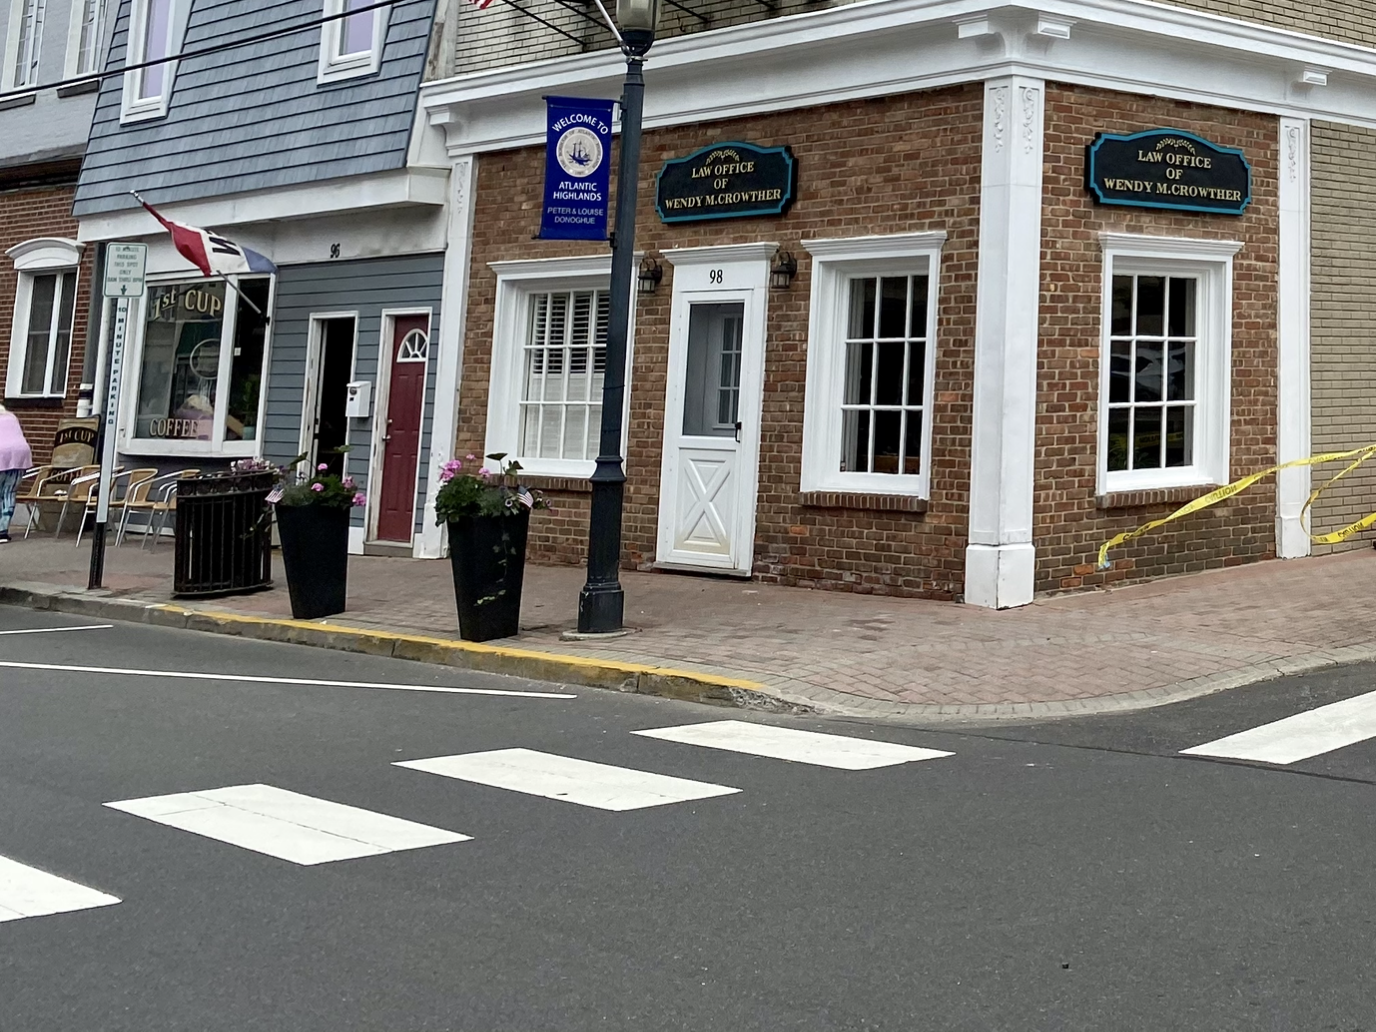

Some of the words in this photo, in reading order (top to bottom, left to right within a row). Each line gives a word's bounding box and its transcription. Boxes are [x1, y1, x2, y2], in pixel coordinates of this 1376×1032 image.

[552, 114, 597, 132] WELCOME
[596, 122, 608, 134] TO
[1138, 150, 1164, 163] LAW
[1166, 153, 1212, 169] OFFICE
[692, 165, 712, 178] LAW
[714, 161, 755, 174] OFFICE
[1166, 168, 1184, 180] OF
[558, 182, 597, 191] ATLANTIC
[714, 178, 728, 190] OF
[1104, 178, 1154, 194] WENDY
[553, 191, 602, 201] HIGHLANDS
[664, 195, 703, 210] WENDY
[554, 216, 595, 224] DONOGHUE
[330, 243, 340, 258] 96
[709, 270, 723, 284] 98
[153, 288, 177, 320] 1st
[185, 289, 222, 317] CUP
[114, 318, 124, 364] MINUTE
[108, 370, 119, 424] PARKING
[150, 418, 198, 438] COFFEE
[74, 430, 94, 442] CUP
